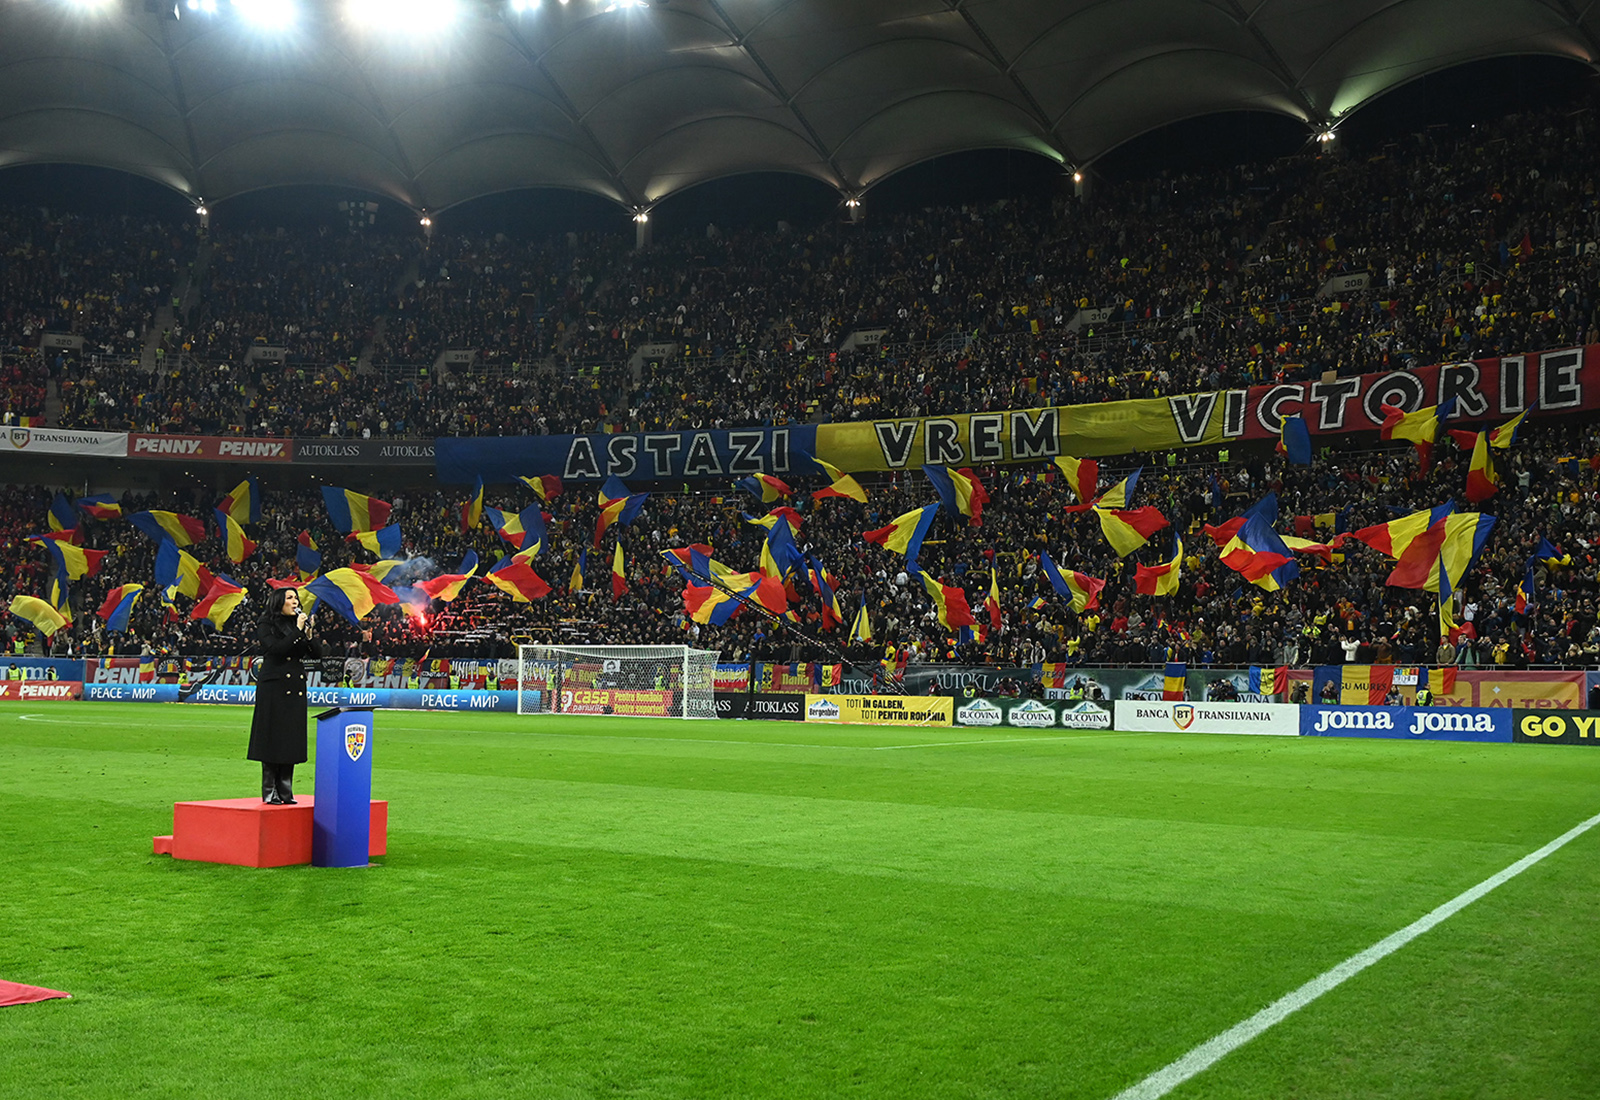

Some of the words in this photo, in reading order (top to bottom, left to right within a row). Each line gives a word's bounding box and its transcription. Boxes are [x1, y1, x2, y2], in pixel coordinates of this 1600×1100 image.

[1344, 279, 1363, 288] 308
[1091, 312, 1108, 321] 310
[55, 338, 72, 346] 320
[864, 334, 879, 342] 312
[874, 409, 1061, 468] VREM
[1167, 347, 1584, 443] VICTORIE
[33, 433, 99, 445] TRANSILVANIA
[298, 445, 360, 456] AUTOKLASS
[379, 446, 435, 457] AUTOKLAS
[91, 687, 122, 698] PEACE
[132, 688, 156, 699] МИР
[196, 689, 228, 700] PEACE
[238, 690, 256, 702] МИ
[306, 691, 338, 704] PEACE
[349, 692, 377, 705] МИР
[574, 690, 610, 704] casa
[421, 694, 458, 707] PEACE
[469, 695, 499, 708] МИР
[872, 699, 905, 711] GALBEN,
[877, 710, 908, 720] PENTRU
[910, 709, 945, 722] ROMÂNIA
[959, 710, 1000, 720] BUCOVINA
[1011, 711, 1053, 721] BUCOVINA
[1065, 713, 1108, 723] BUCOVINA
[1136, 709, 1169, 719] BANCA
[1177, 710, 1190, 719] BT
[1197, 710, 1272, 721] TRANSILVANIA
[1520, 715, 1566, 738] GO
